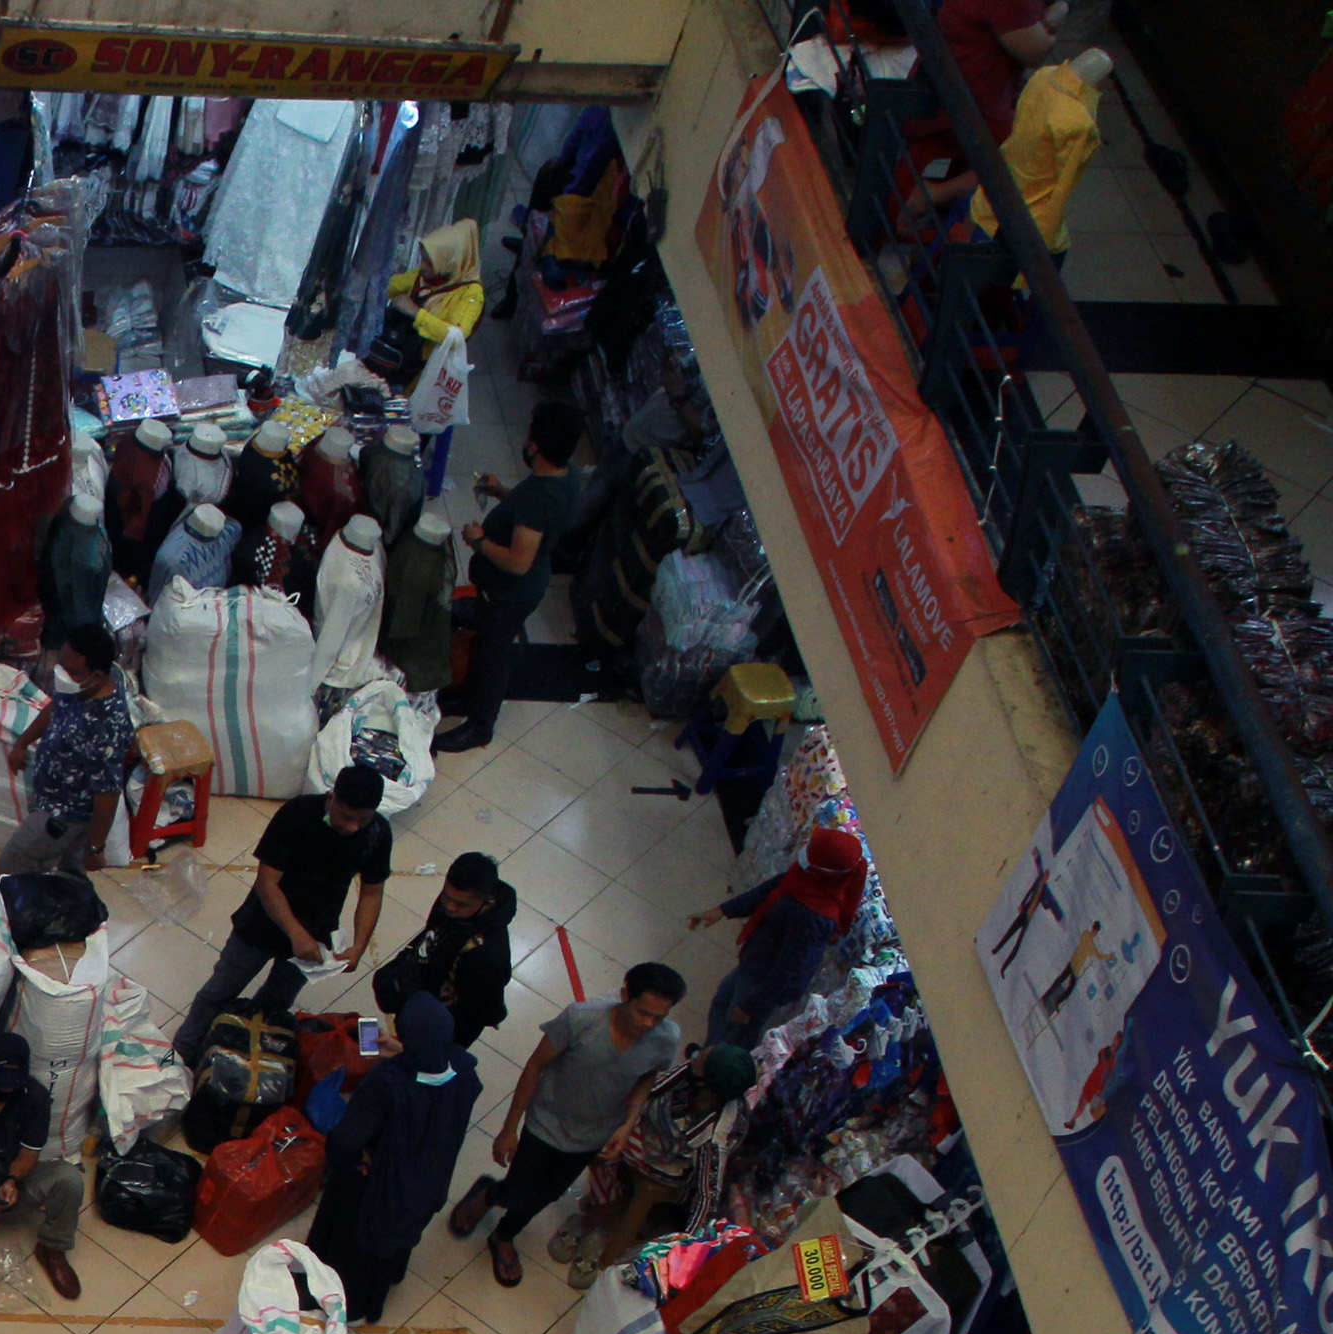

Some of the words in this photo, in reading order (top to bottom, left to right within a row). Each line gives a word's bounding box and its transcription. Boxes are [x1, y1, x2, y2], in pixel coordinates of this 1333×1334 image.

[11, 46, 65, 69] SC
[92, 38, 489, 86] SONY-RANGGA
[788, 297, 881, 497] GRATIS
[784, 383, 850, 529] LAPASARJAYA
[890, 517, 954, 653] LALAMOVE
[1151, 1070, 1202, 1155] DENGAN
[1210, 974, 1299, 1182] Yuk
[1128, 1115, 1158, 1172] YANG
[1138, 1094, 1201, 1220] PELANGGAN,
[1197, 1099, 1236, 1173] BANTU
[804, 1249, 824, 1291] 30.000
[821, 1239, 836, 1263] HARGA
[825, 1263, 841, 1292] SPECIAL
